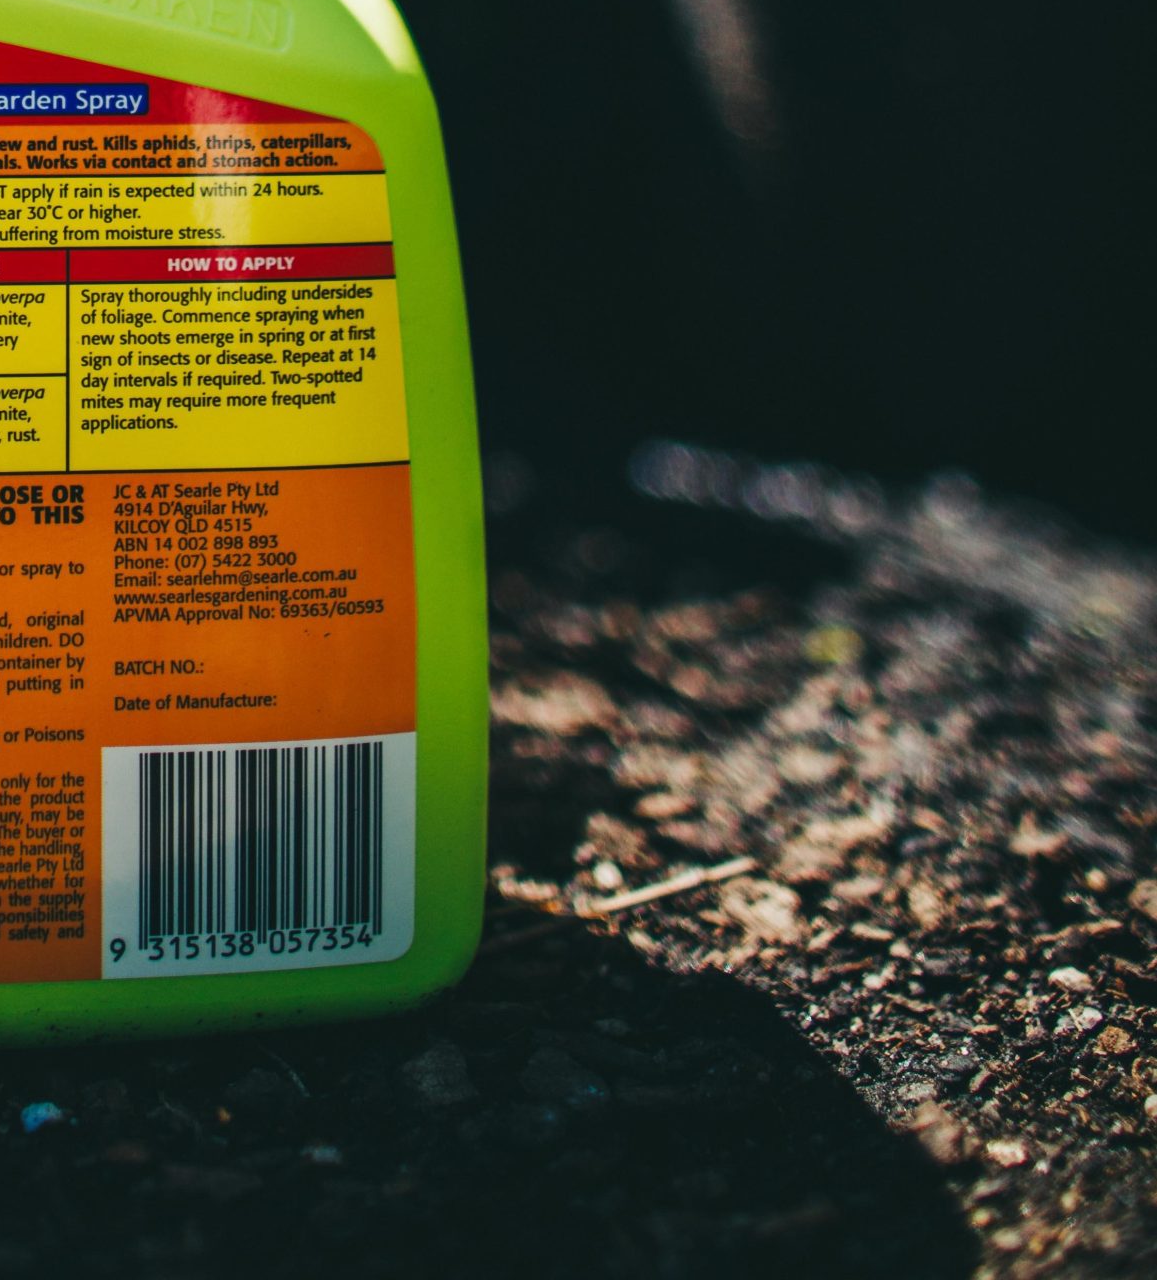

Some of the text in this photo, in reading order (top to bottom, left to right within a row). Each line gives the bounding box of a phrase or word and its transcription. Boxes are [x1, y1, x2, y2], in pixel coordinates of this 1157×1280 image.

[75, 89, 143, 113] Spray
[26, 135, 58, 152] and
[62, 136, 98, 151] rust.
[102, 135, 138, 151] Kills
[141, 134, 200, 155] aphids,
[205, 134, 256, 155] thrips,
[260, 132, 352, 154] caterpillars,
[67, 208, 84, 220] or
[88, 203, 140, 224] higher.
[167, 256, 295, 271] HOW TO APPLY
[80, 282, 373, 307] Spray thoroughly including undersides
[80, 303, 364, 328] of foliage. Commence spraying when
[7, 428, 40, 443] rust.
[51, 486, 84, 505] OR
[112, 480, 279, 502] JC & AT Searle Pty Ltd
[30, 506, 84, 526] THIS
[113, 501, 154, 516] 4914
[230, 499, 268, 519] Hwy,
[114, 517, 252, 535] KILCOY QLD 4515
[113, 534, 278, 552] ABN 14 002 898 893
[20, 564, 62, 581] spray
[68, 559, 84, 575] to
[114, 551, 297, 573] Phone: (07) 5422 3000
[114, 566, 357, 588] Email: searlehm@searle.com.au
[114, 585, 347, 607] www.searlesgardening.com.au
[112, 599, 384, 625] APVMA Approval No: 69363/60593
[113, 660, 203, 675] BATCH NO.:
[114, 690, 276, 711] Date of Manufacture:
[0, 773, 30, 794] only
[36, 773, 56, 789] for
[60, 771, 84, 788] the
[109, 924, 373, 962] 9 315138 057354
